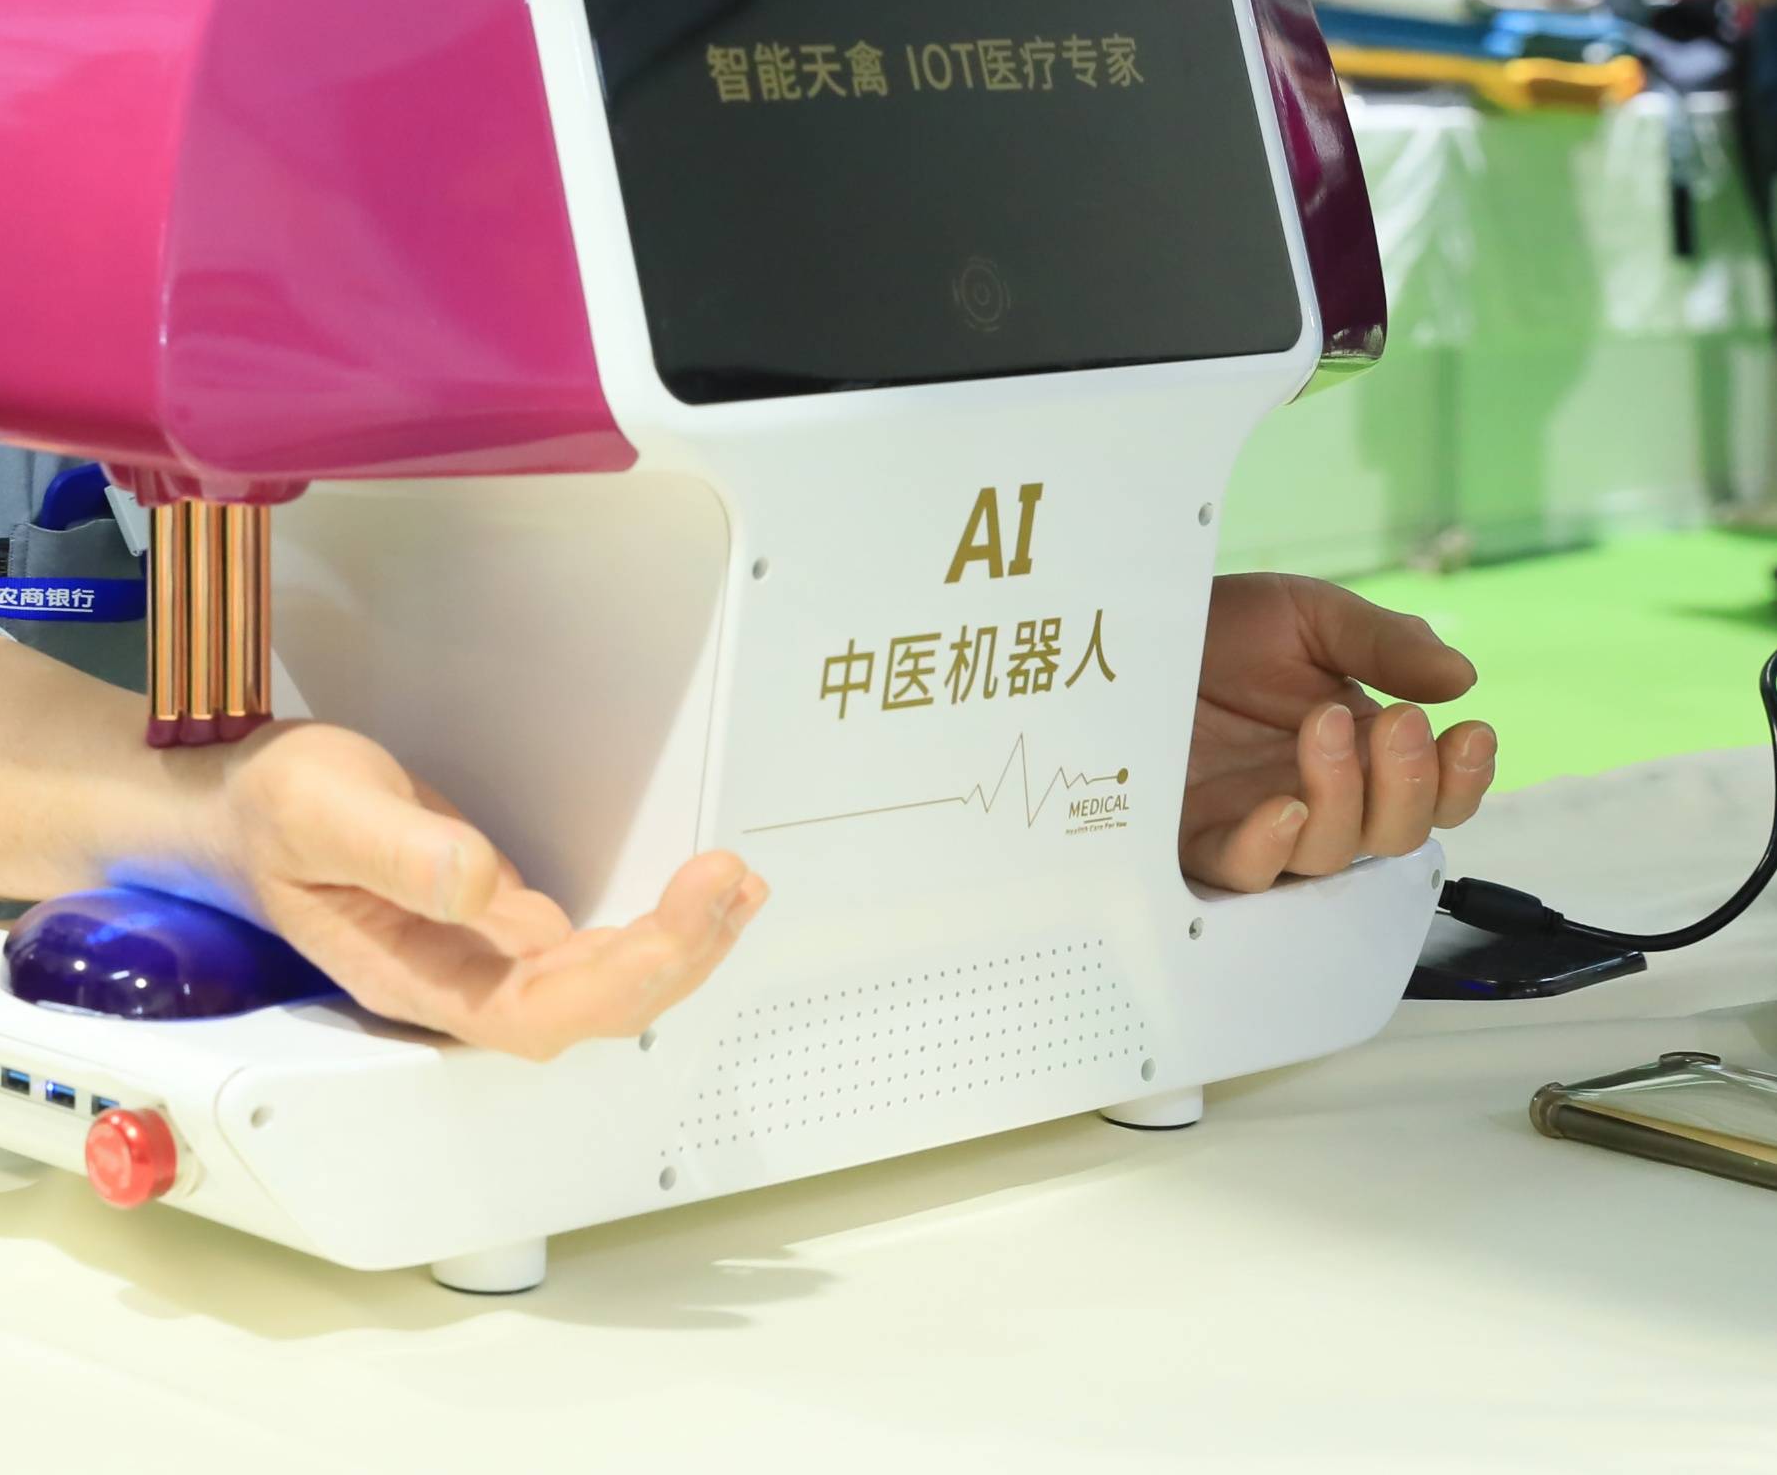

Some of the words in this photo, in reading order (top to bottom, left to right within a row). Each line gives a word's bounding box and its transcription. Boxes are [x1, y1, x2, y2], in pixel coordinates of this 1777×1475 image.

[706, 39, 889, 103] 智能天禽
[905, 33, 1145, 92] IOT医疗专家
[944, 482, 1043, 584] AI
[820, 609, 1116, 720] 中医机器人
[1069, 794, 1129, 819] MEDICAL
